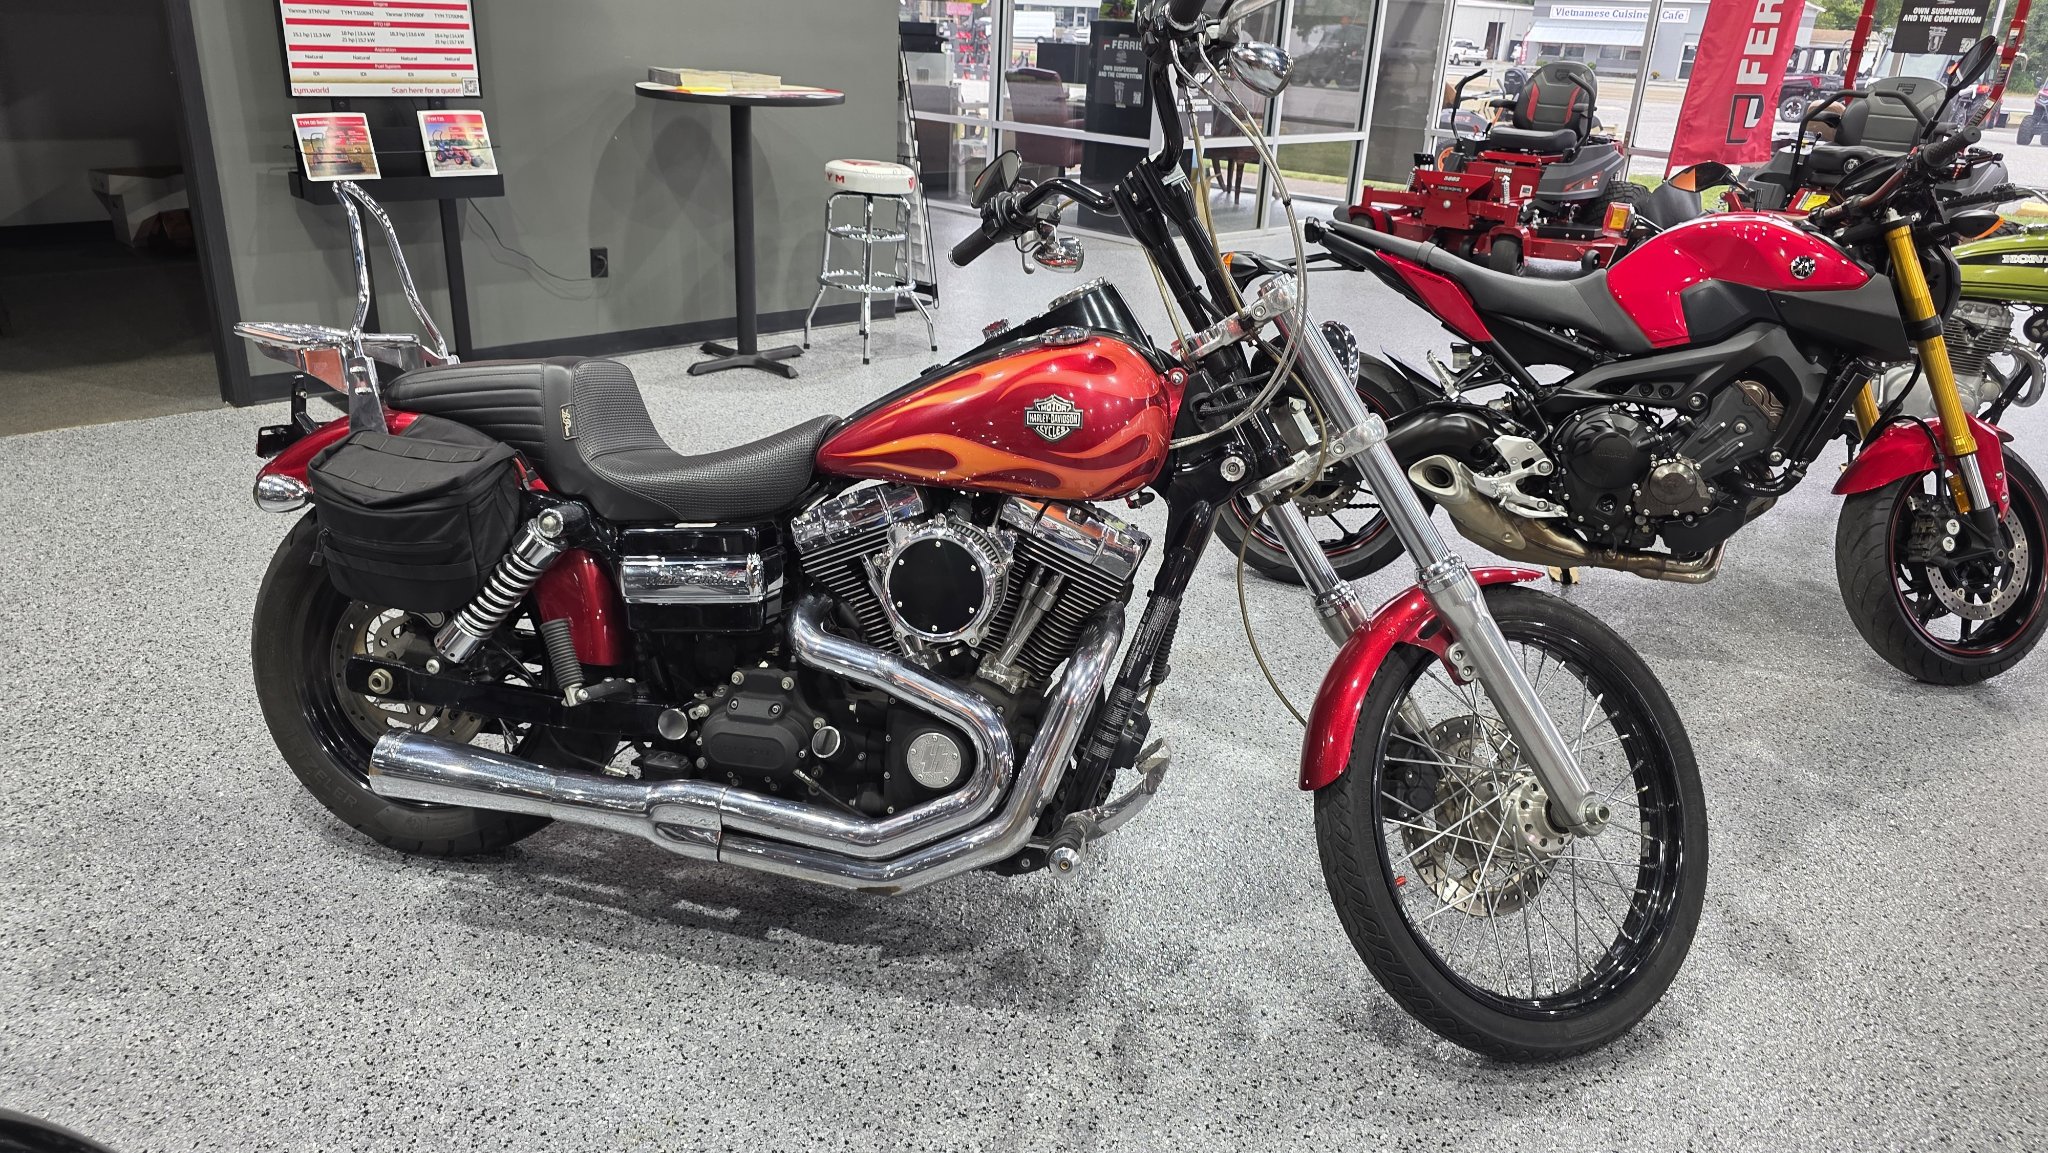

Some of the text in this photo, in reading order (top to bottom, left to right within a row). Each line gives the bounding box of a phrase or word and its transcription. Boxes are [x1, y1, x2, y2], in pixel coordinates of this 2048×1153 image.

[1555, 8, 1685, 20] Vietnamese Cuisine Cafe
[1913, 7, 1976, 16] OWN SUSPENSION
[1903, 14, 1919, 22] AND
[1934, 15, 1981, 24] COMPETITION
[293, 86, 330, 94] tym.world
[440, 87, 461, 95] quote!
[1041, 402, 1068, 412] MOTOR
[1039, 425, 1066, 438] CYCLES
